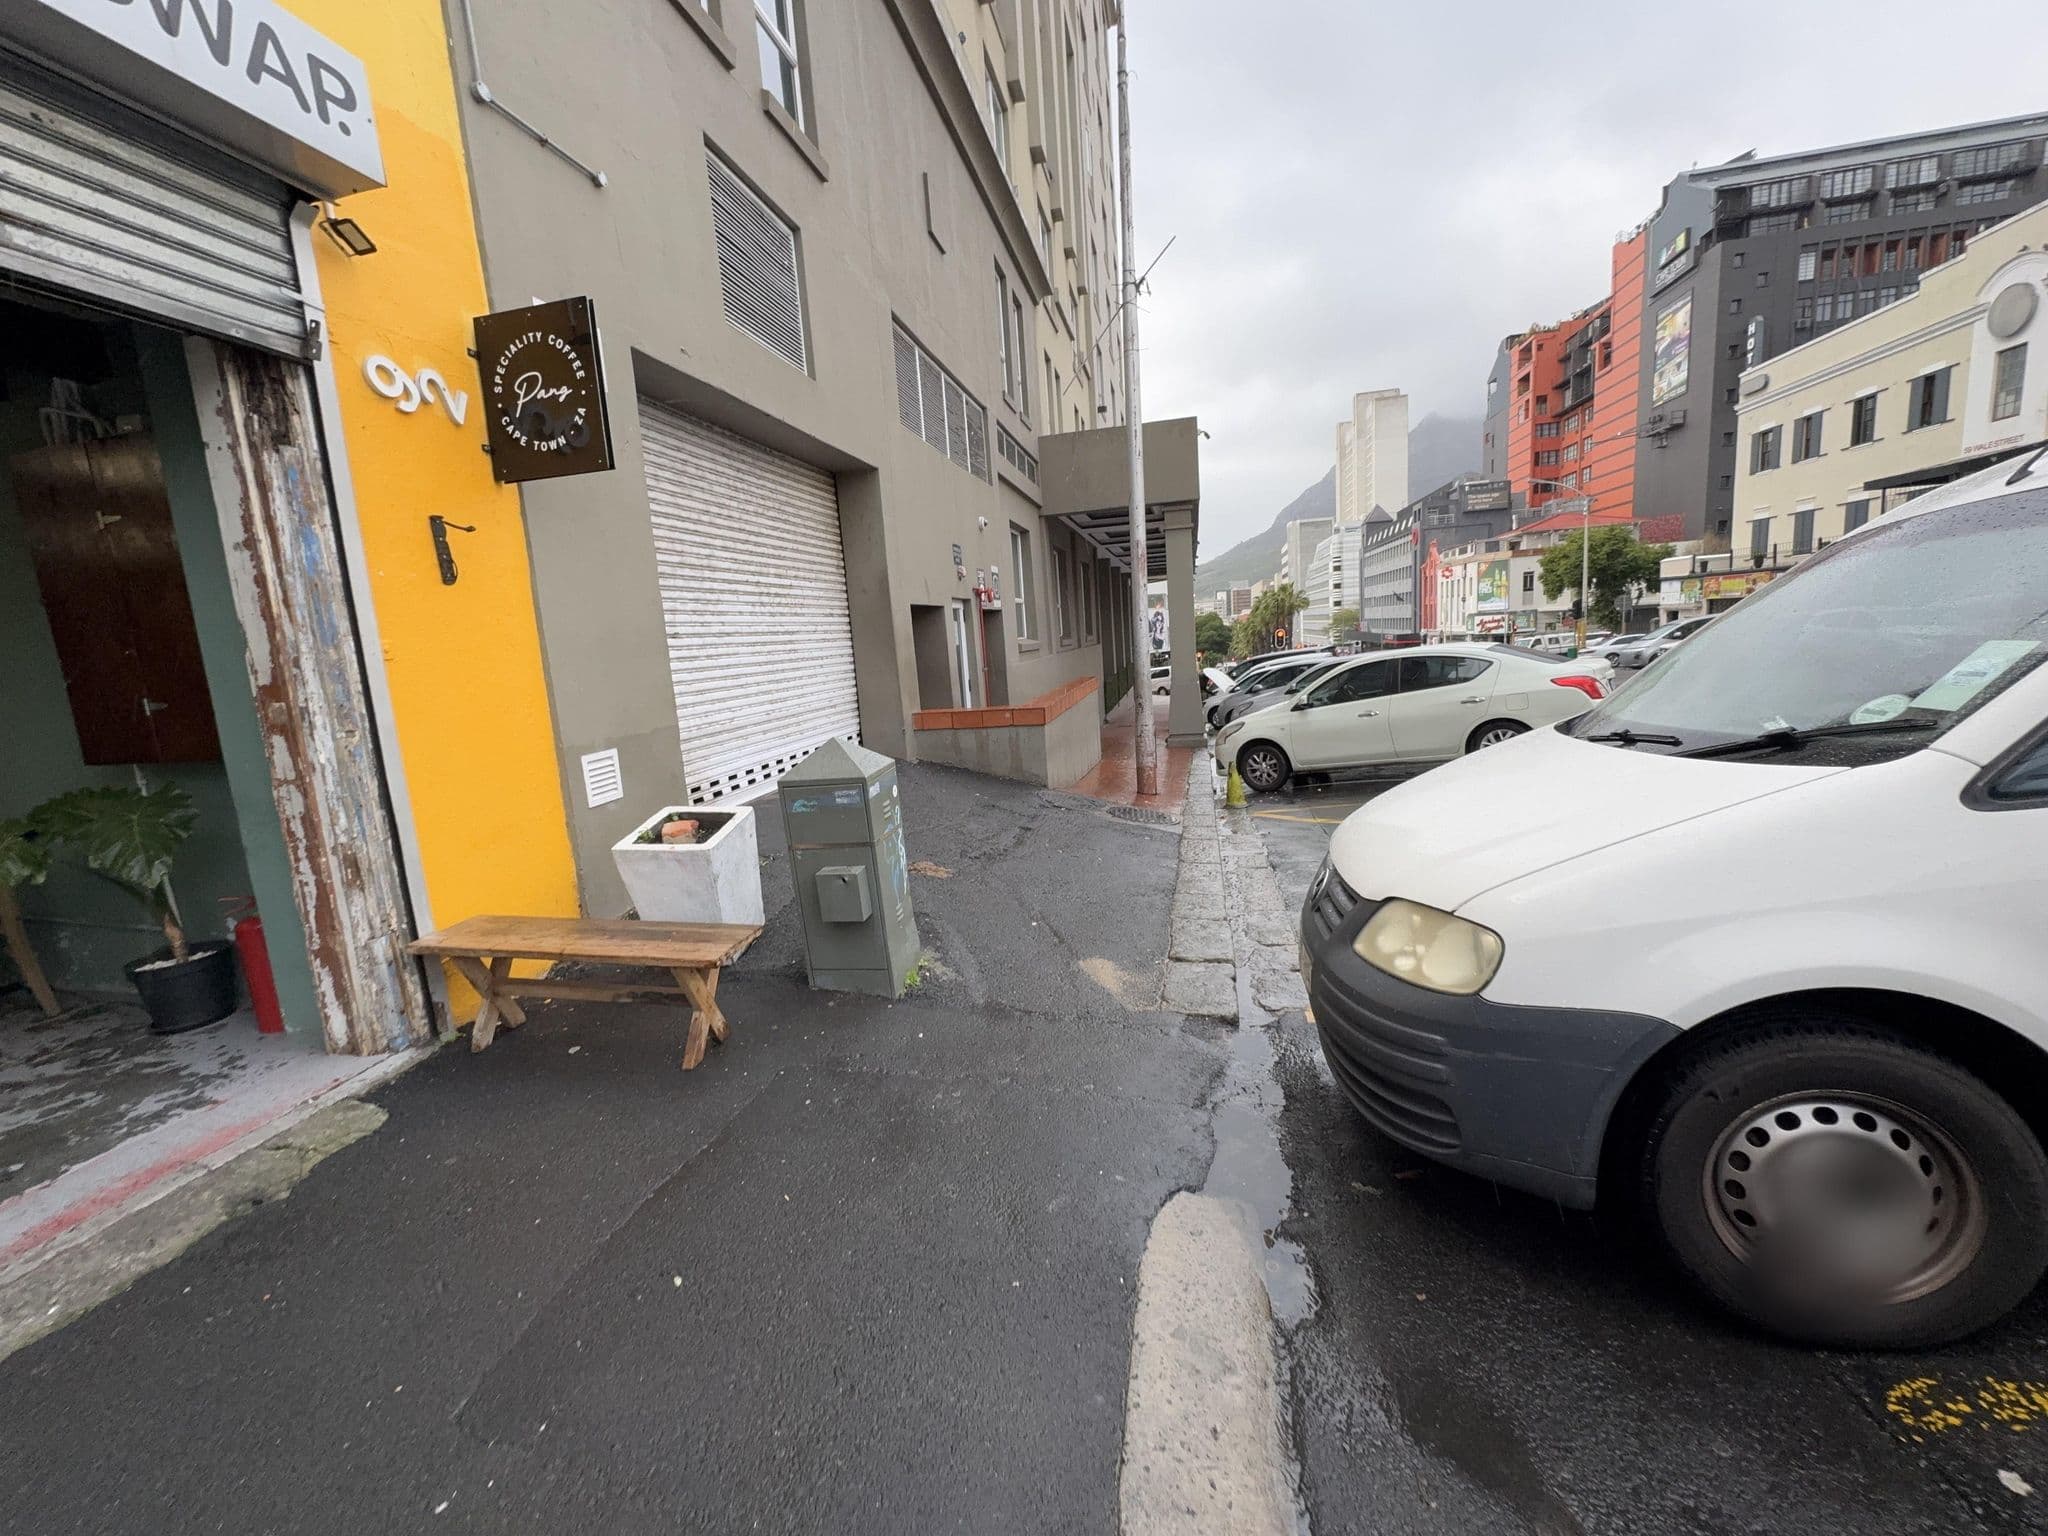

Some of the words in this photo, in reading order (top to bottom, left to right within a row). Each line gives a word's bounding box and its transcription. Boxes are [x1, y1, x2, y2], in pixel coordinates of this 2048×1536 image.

[103, 0, 358, 137] WAP.
[494, 332, 542, 393] SPECIALITY
[548, 335, 585, 379] COFFEE
[363, 355, 468, 426] 92
[514, 372, 572, 417] Pang
[501, 417, 527, 446] CAPE
[533, 435, 566, 451] TOWN
[574, 408, 586, 425] ZA
[1993, 434, 2025, 447] STREET
